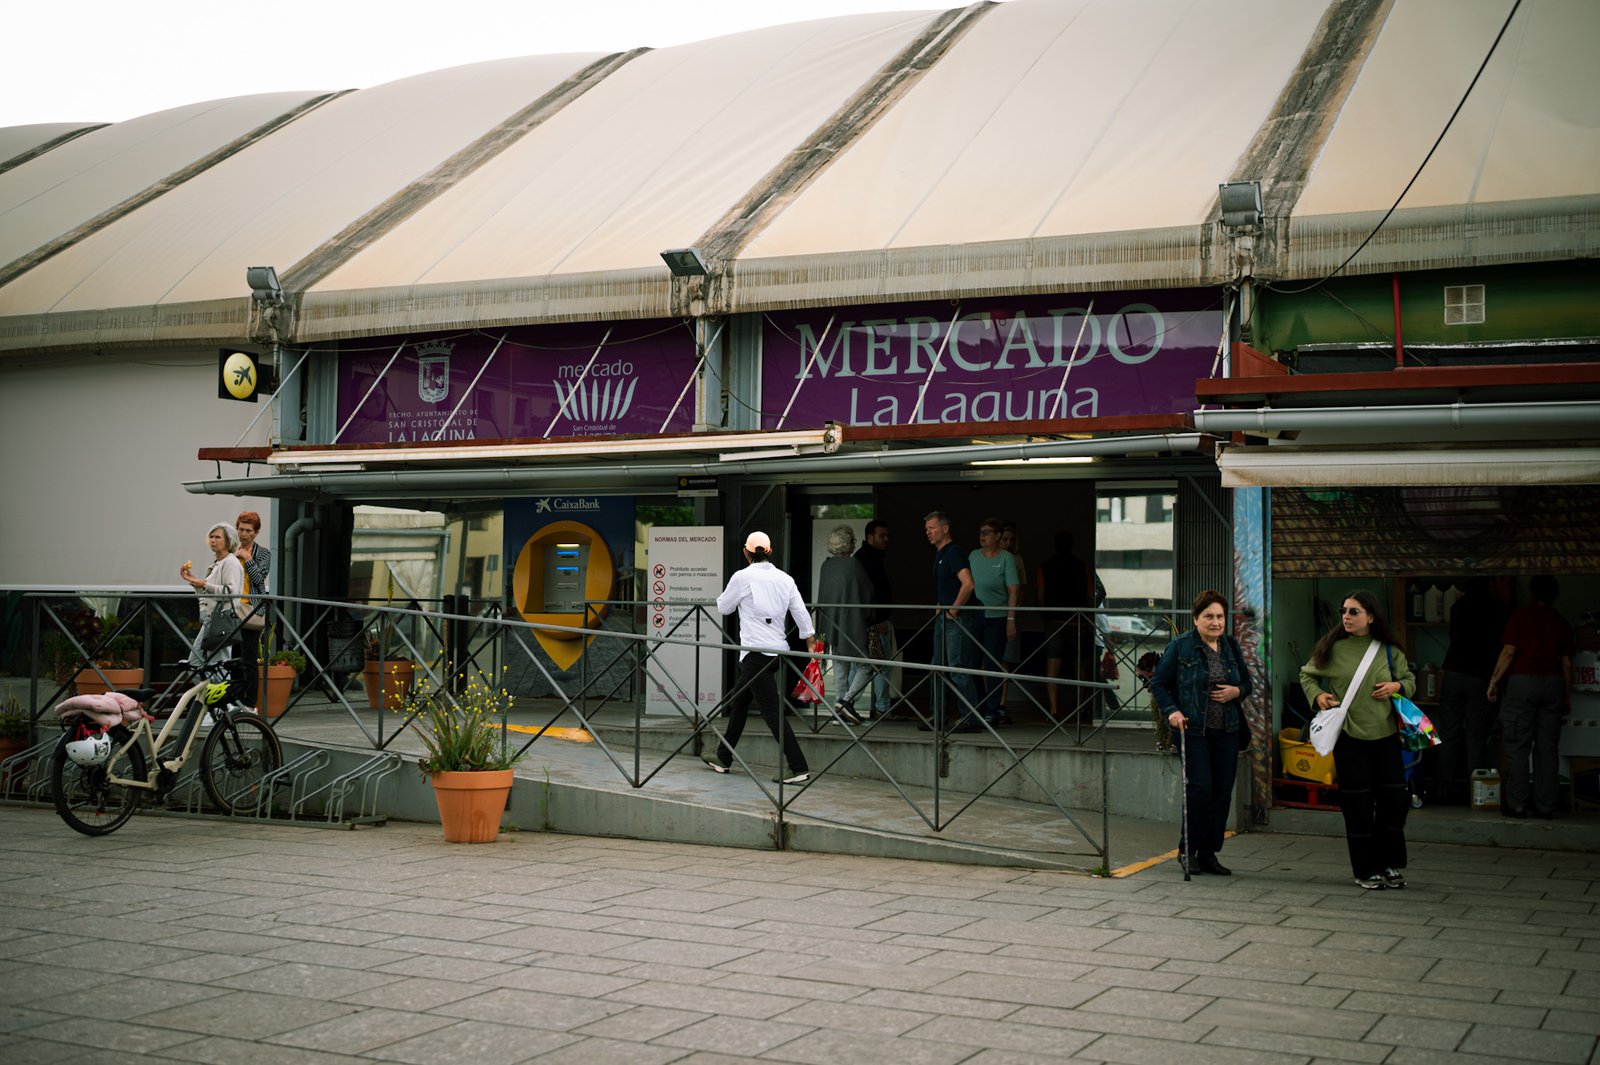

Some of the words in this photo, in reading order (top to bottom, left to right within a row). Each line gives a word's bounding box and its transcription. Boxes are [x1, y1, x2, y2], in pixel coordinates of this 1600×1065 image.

[795, 303, 1165, 379] MERCADO
[850, 388, 899, 427] La
[916, 386, 1099, 425] Laguna
[389, 421, 406, 429] SAN
[411, 418, 462, 428] CRISTÓAL
[467, 418, 478, 426] DE
[554, 498, 600, 509] CaixaBank
